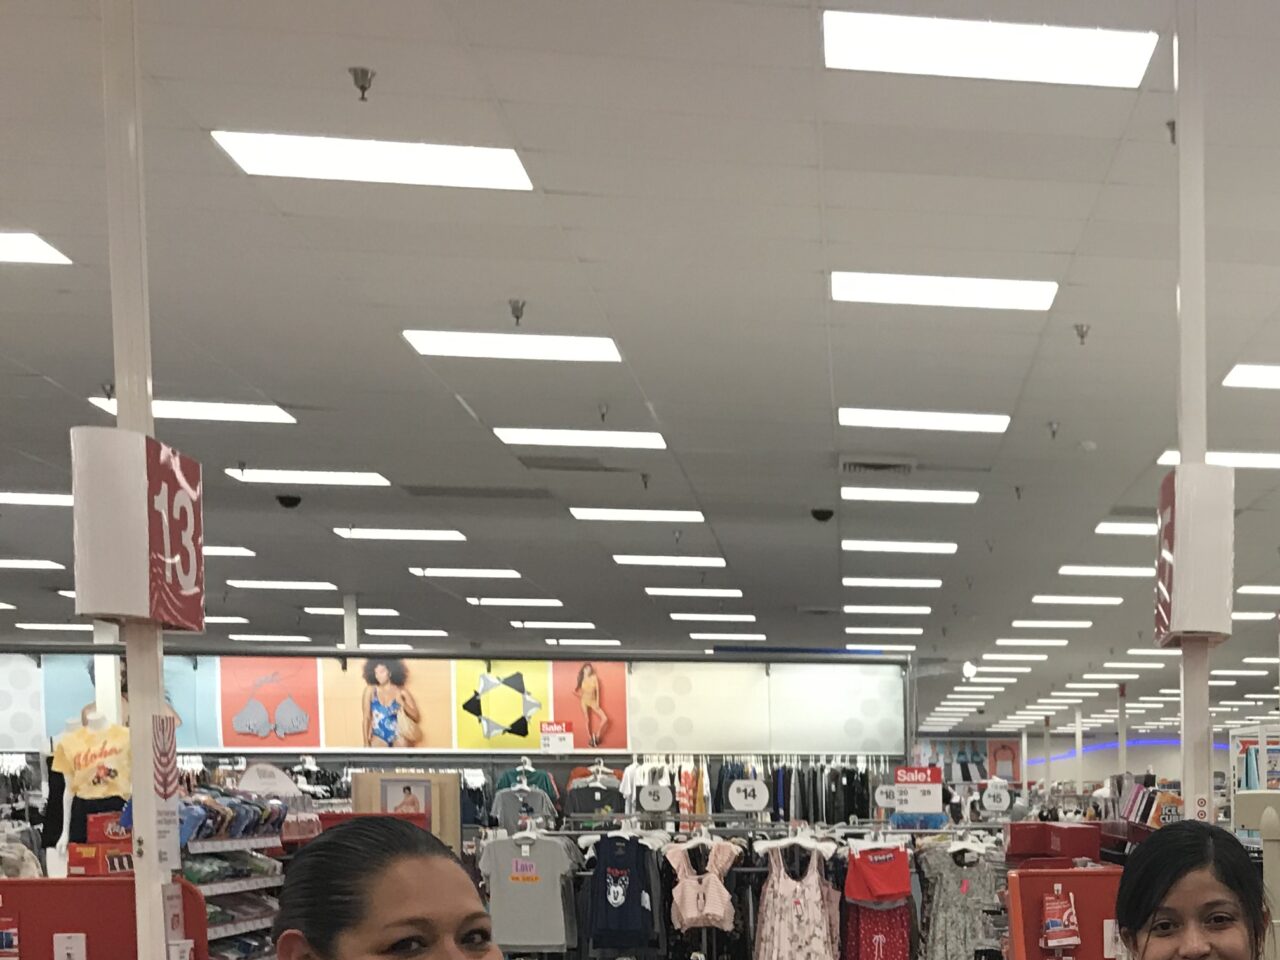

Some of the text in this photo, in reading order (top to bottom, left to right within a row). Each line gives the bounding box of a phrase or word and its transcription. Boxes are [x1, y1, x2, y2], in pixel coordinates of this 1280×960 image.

[154, 480, 198, 592] 13
[541, 721, 566, 733] Sale!
[896, 769, 932, 782] Sale!
[735, 786, 756, 800] $14
